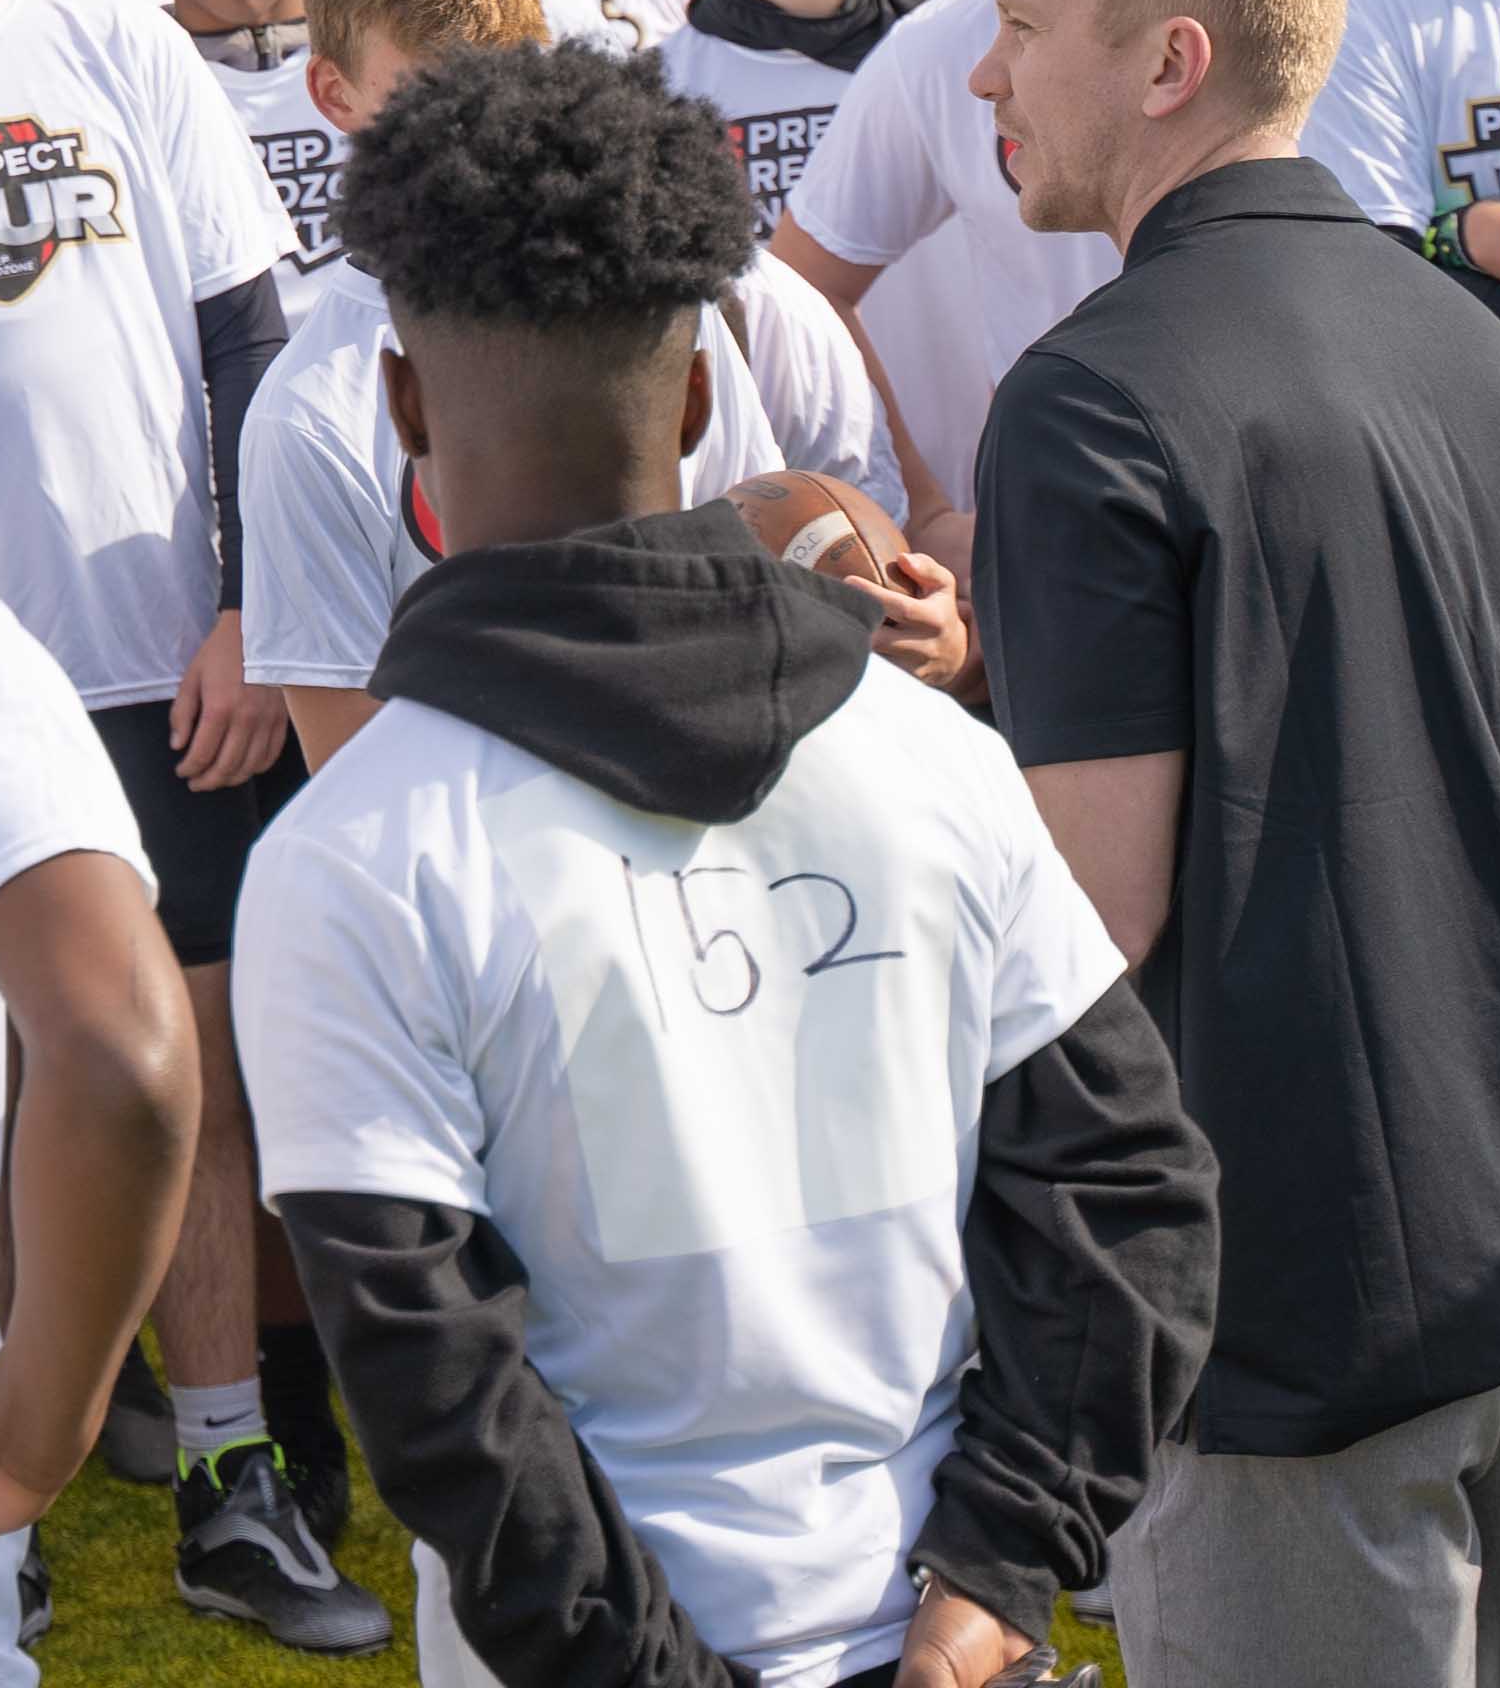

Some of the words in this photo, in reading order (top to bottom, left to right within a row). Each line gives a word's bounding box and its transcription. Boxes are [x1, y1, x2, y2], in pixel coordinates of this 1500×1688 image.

[253, 135, 326, 174] EP
[747, 112, 835, 156] PRE
[621, 853, 907, 1033] 152
